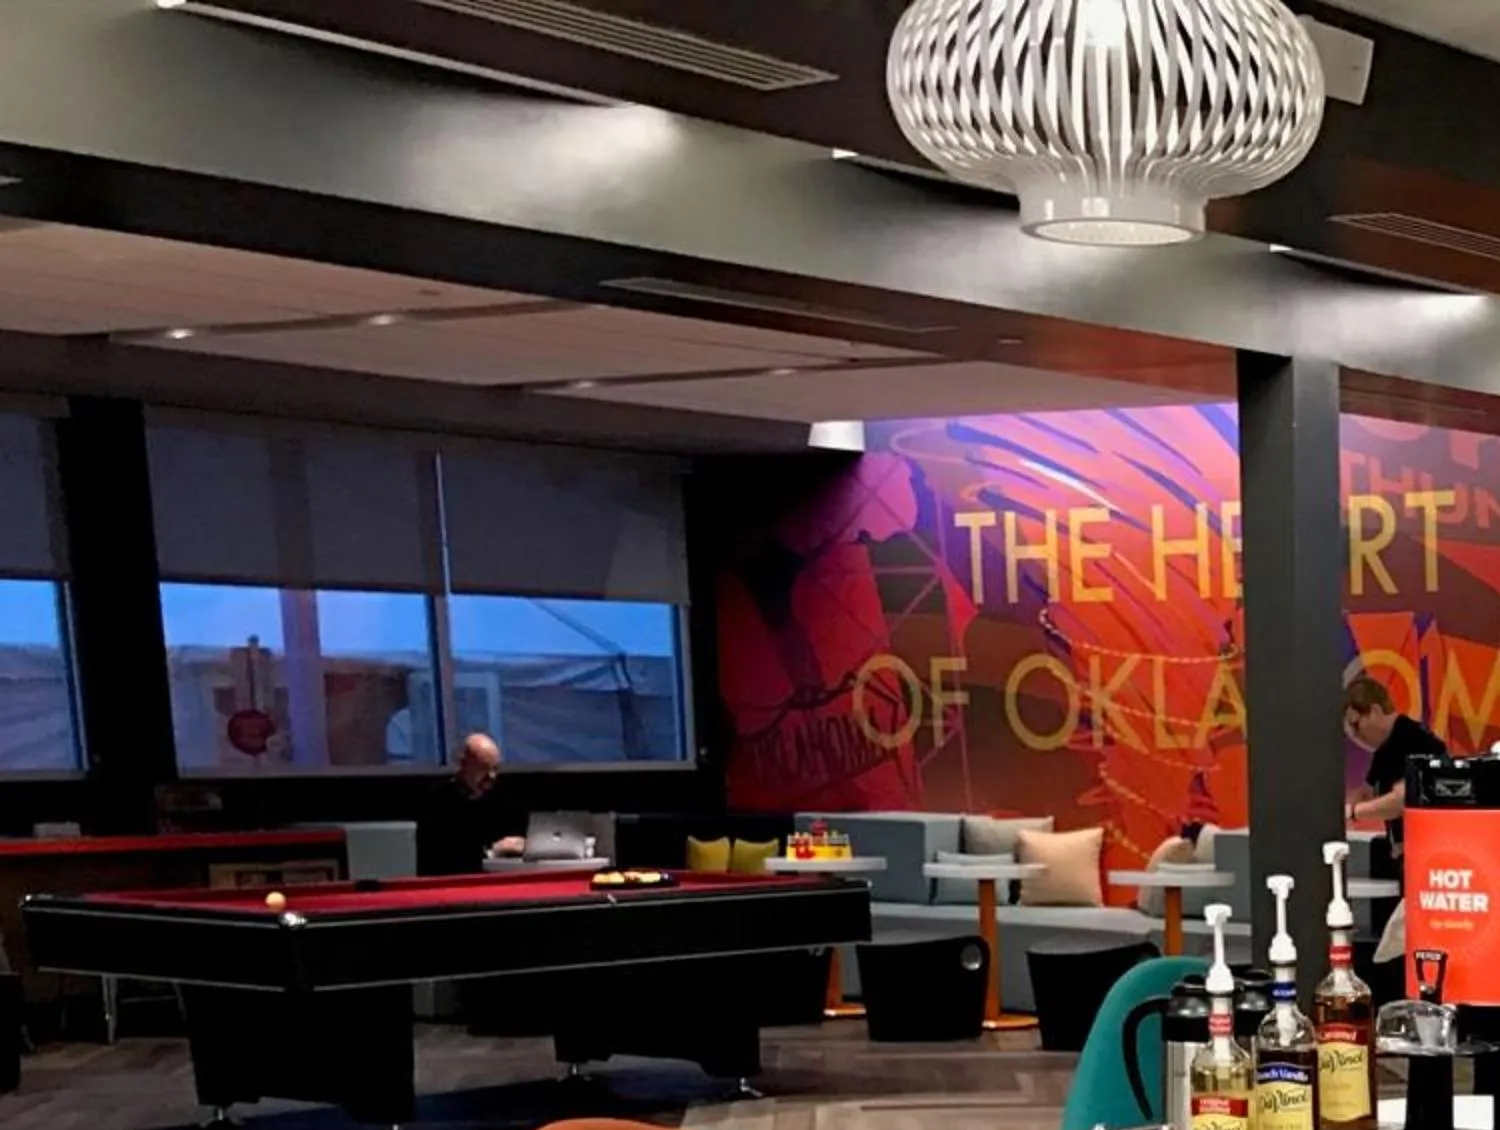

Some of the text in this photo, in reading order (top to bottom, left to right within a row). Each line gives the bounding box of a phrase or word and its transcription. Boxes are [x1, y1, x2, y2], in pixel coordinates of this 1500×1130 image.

[954, 490, 1455, 604] THE HERT
[852, 654, 970, 750] OF
[1419, 890, 1489, 913] WATER
[1429, 869, 1473, 889] HOT
